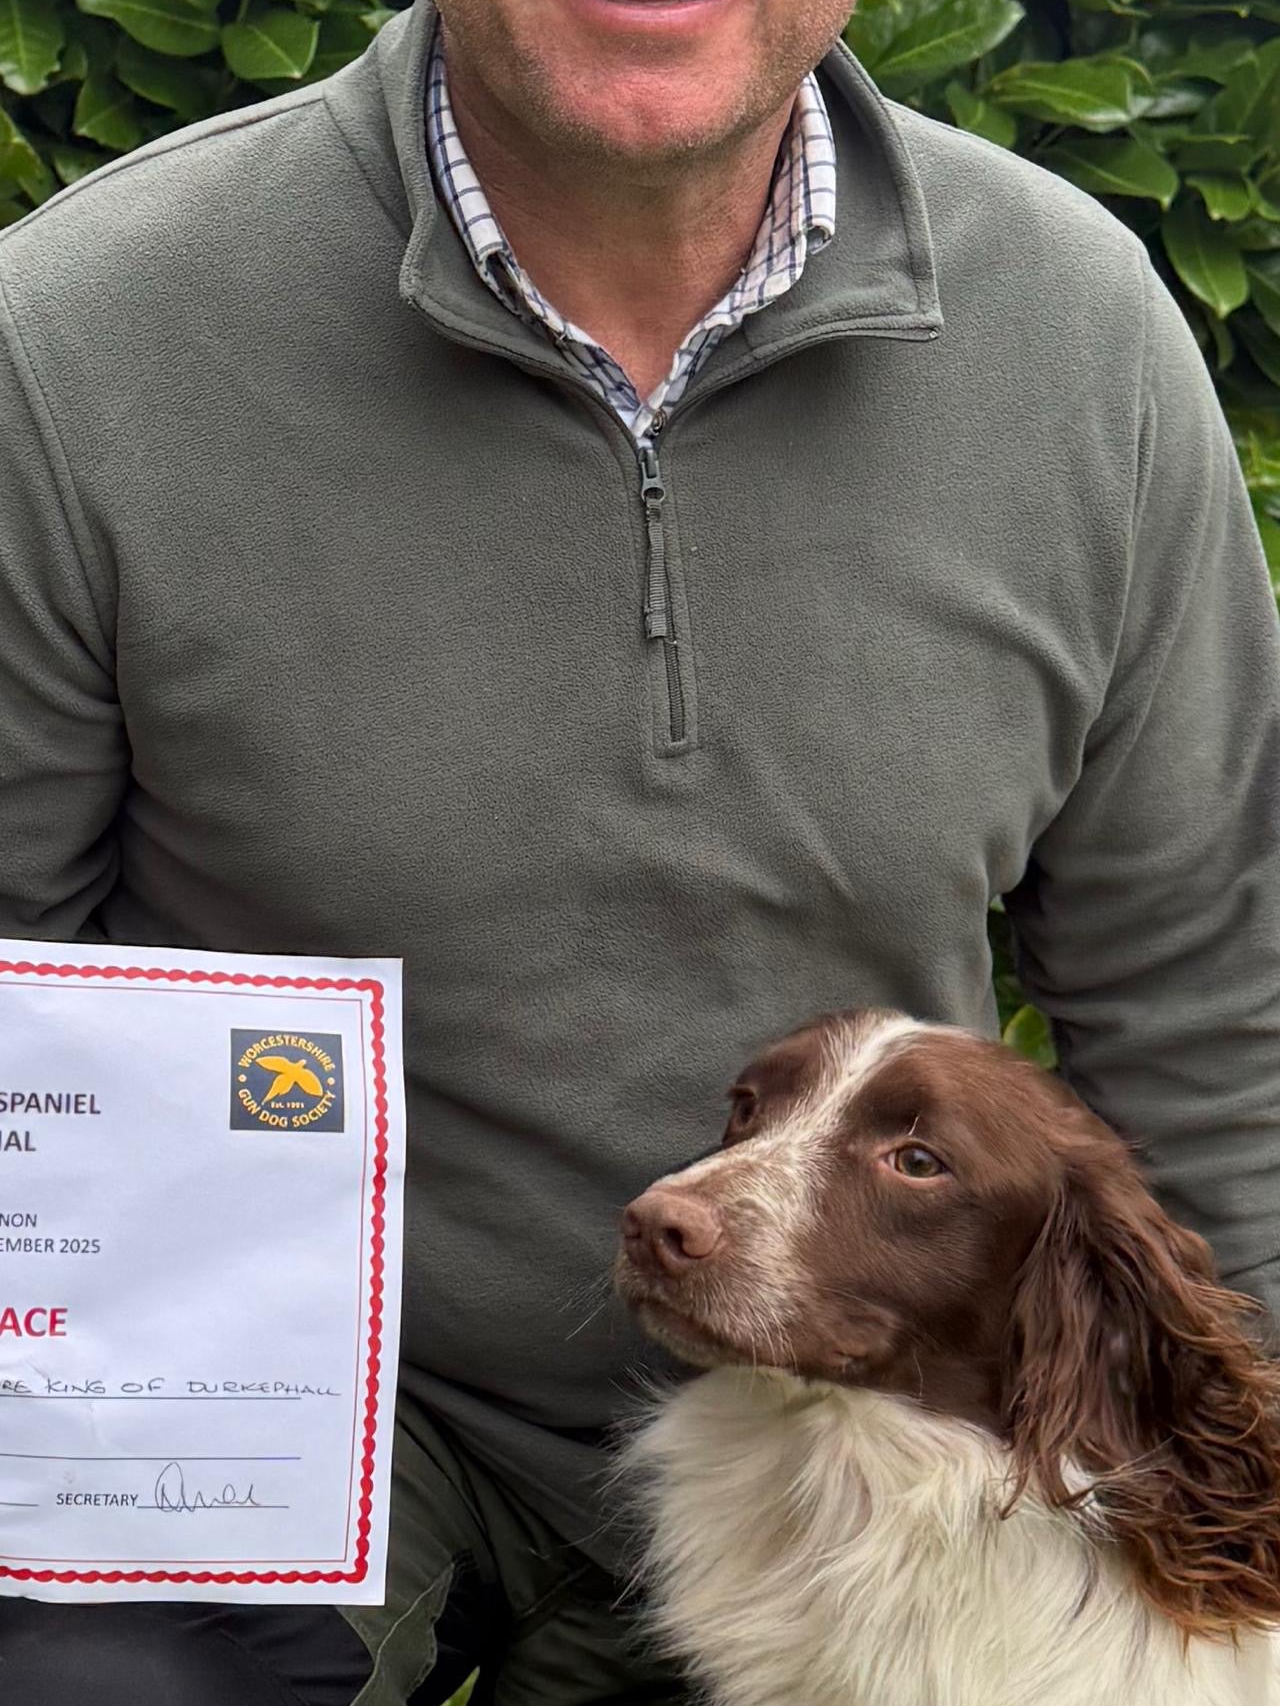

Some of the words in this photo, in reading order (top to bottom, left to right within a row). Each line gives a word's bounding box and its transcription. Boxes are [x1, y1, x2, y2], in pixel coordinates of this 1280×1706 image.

[238, 1034, 336, 1072] WORCESTERSHIRE
[238, 1088, 261, 1115] GUN
[259, 1110, 288, 1128] DOG
[291, 1090, 336, 1128] SOCIETY
[59, 1238, 101, 1254] 2025
[44, 1377, 107, 1395] KING
[119, 1377, 166, 1394] OF
[55, 1492, 140, 1508] SECRETARY
